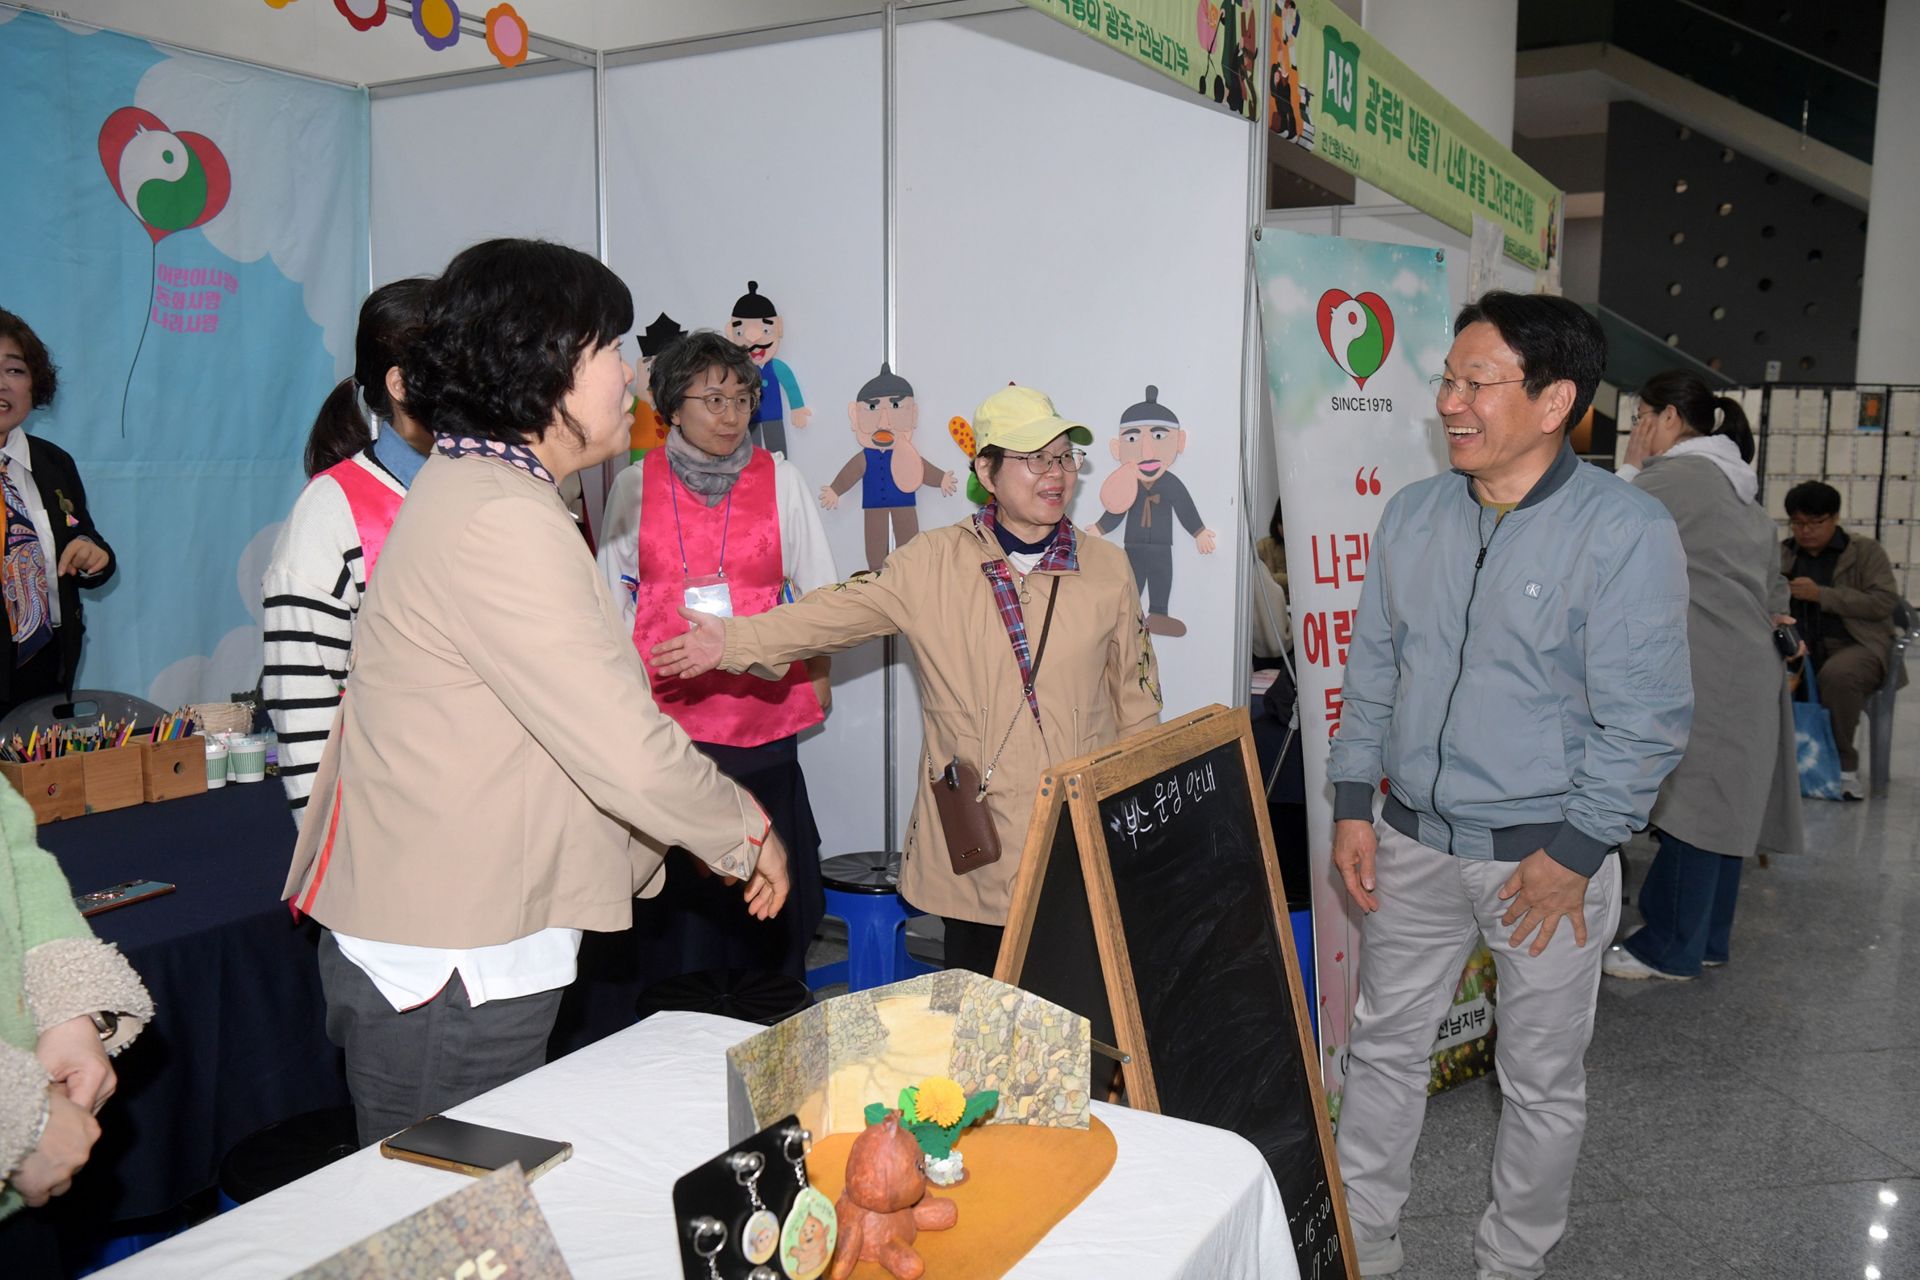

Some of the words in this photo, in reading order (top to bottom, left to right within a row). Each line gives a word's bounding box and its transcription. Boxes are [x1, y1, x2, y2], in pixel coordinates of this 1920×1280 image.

[1326, 50, 1353, 112] A13
[1408, 106, 1441, 174] 만들기
[1332, 396, 1393, 412] SINCE1978
[1154, 775, 1182, 823] 운영
[1186, 762, 1216, 802] 안내
